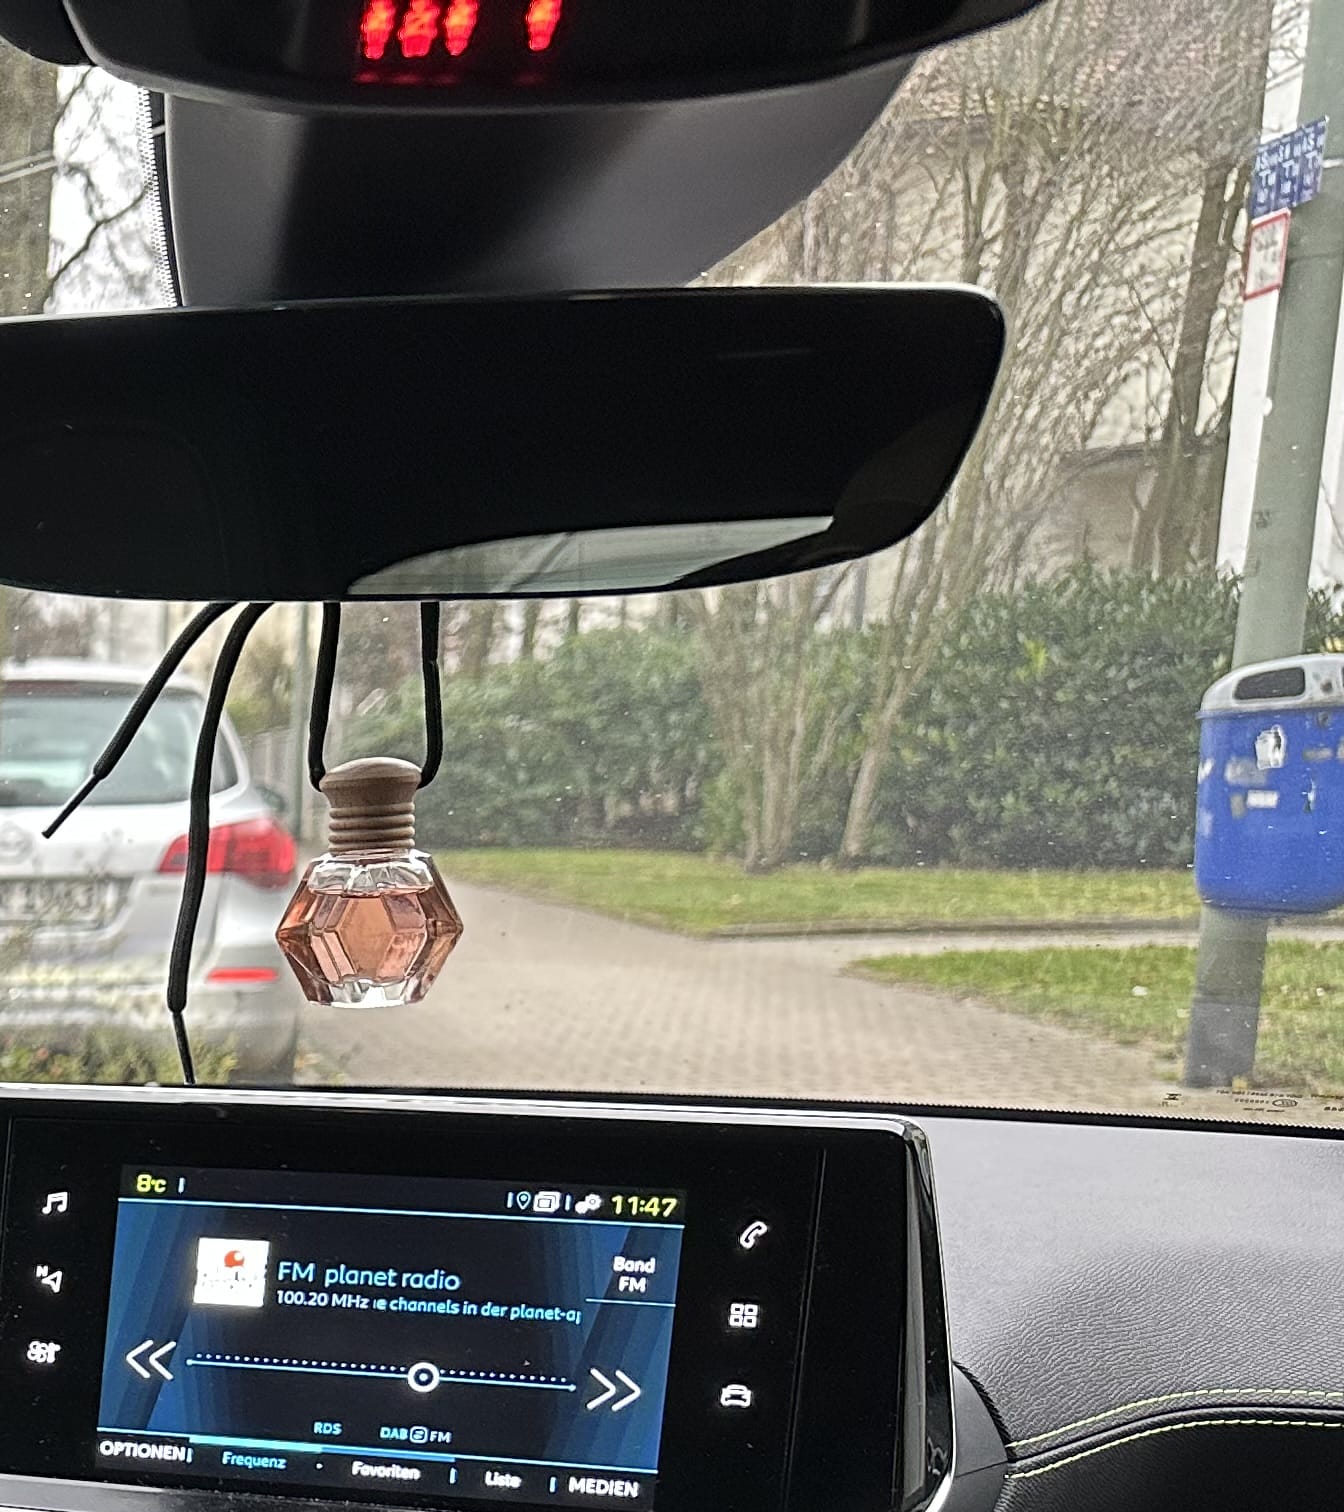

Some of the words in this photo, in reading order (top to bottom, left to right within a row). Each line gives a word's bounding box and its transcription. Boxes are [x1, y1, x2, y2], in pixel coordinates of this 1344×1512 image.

[611, 1195, 678, 1218] 11:47
[613, 1255, 656, 1275] Band
[277, 1261, 316, 1283] FM
[324, 1263, 398, 1288] planet
[401, 1268, 461, 1291] radio
[618, 1276, 647, 1293] FM
[276, 1290, 329, 1306] 100.20
[331, 1293, 370, 1309] MHz
[389, 1296, 461, 1315] channels
[463, 1300, 478, 1316] in
[480, 1301, 508, 1318] der
[313, 1422, 343, 1436] RDS
[379, 1426, 409, 1441] DAB
[430, 1430, 452, 1444] FM
[99, 1440, 186, 1463] OPTIONEN
[222, 1451, 288, 1470] Frequenz
[351, 1461, 421, 1481] Favoriten
[484, 1471, 523, 1488] Liste
[568, 1476, 640, 1498] MEDIEN
